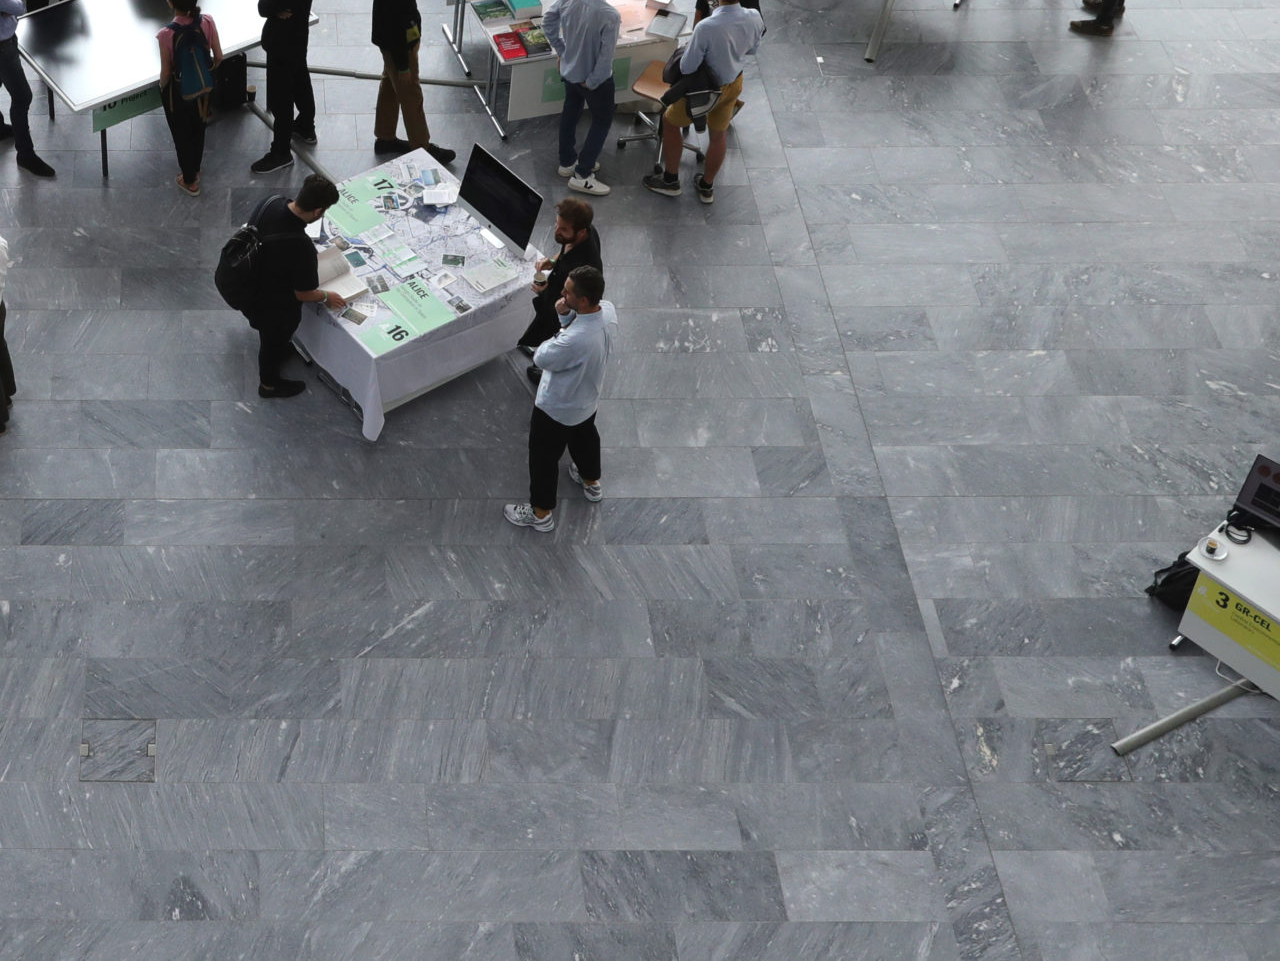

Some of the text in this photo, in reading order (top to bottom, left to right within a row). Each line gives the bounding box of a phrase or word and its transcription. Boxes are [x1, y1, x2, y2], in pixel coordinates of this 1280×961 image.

[374, 178, 394, 191] 17
[340, 188, 360, 205] ALICE
[407, 281, 430, 299] ALICE
[387, 324, 409, 342] 16
[1215, 591, 1230, 609] 3
[1234, 602, 1272, 632] GR-CEL
